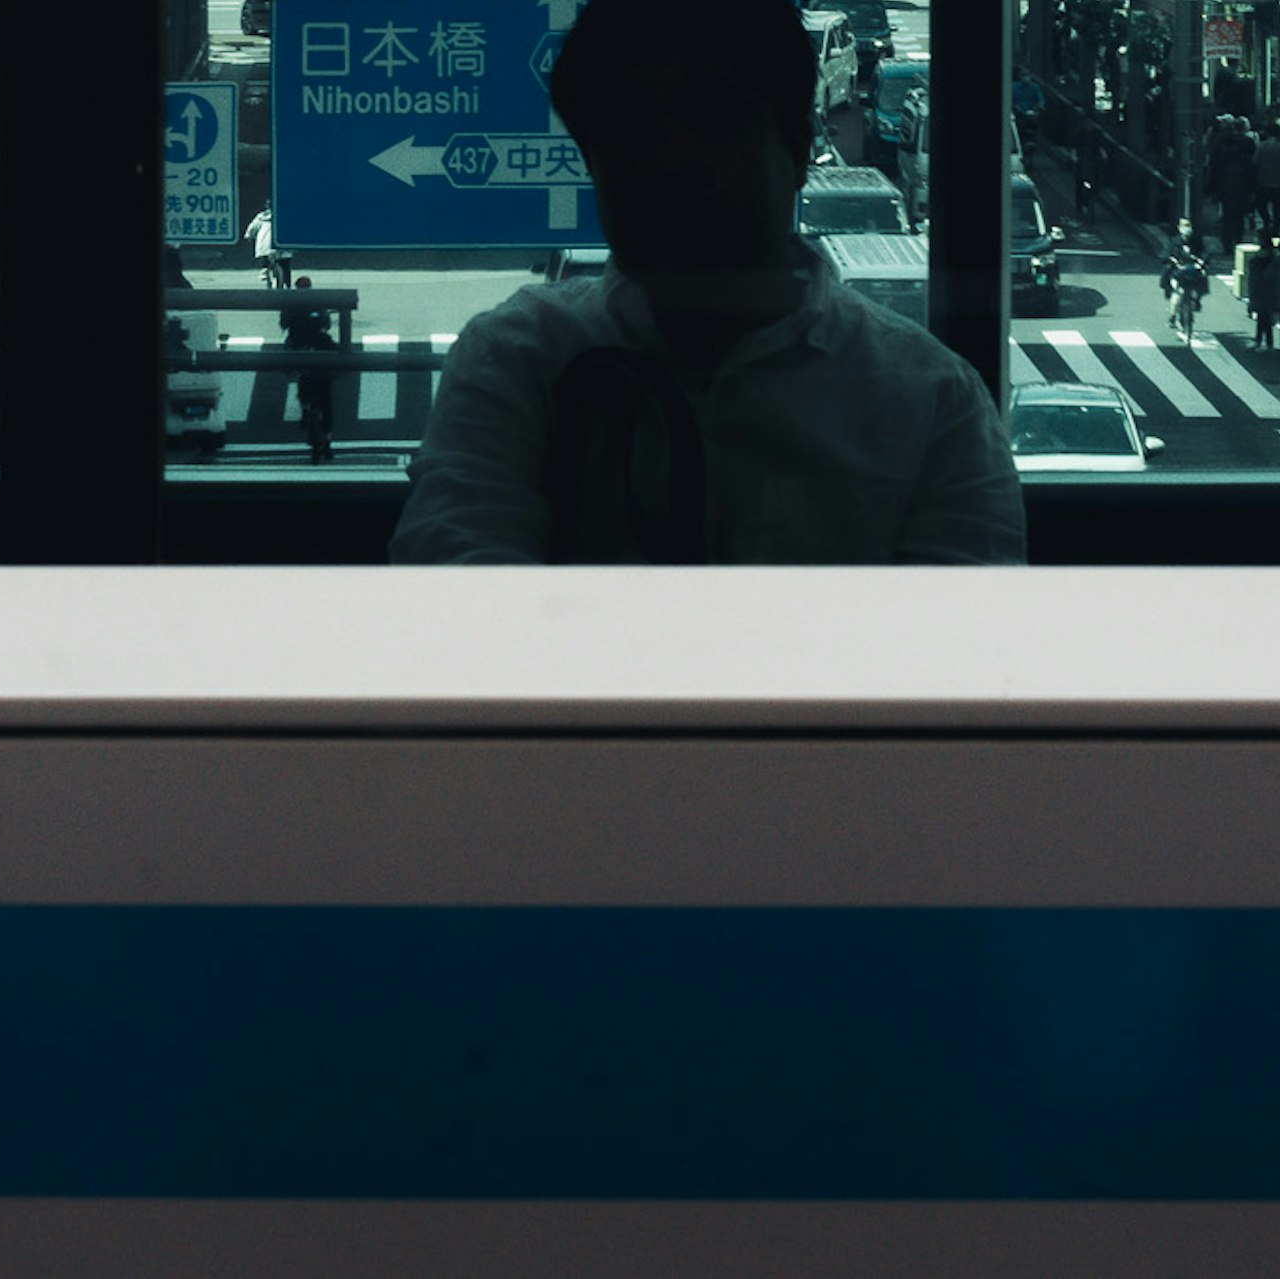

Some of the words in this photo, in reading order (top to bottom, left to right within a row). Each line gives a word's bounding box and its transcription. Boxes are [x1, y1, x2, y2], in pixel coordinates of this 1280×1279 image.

[301, 20, 488, 78] 日本橋
[302, 85, 480, 114] Nihonbashi
[448, 147, 492, 174] 437
